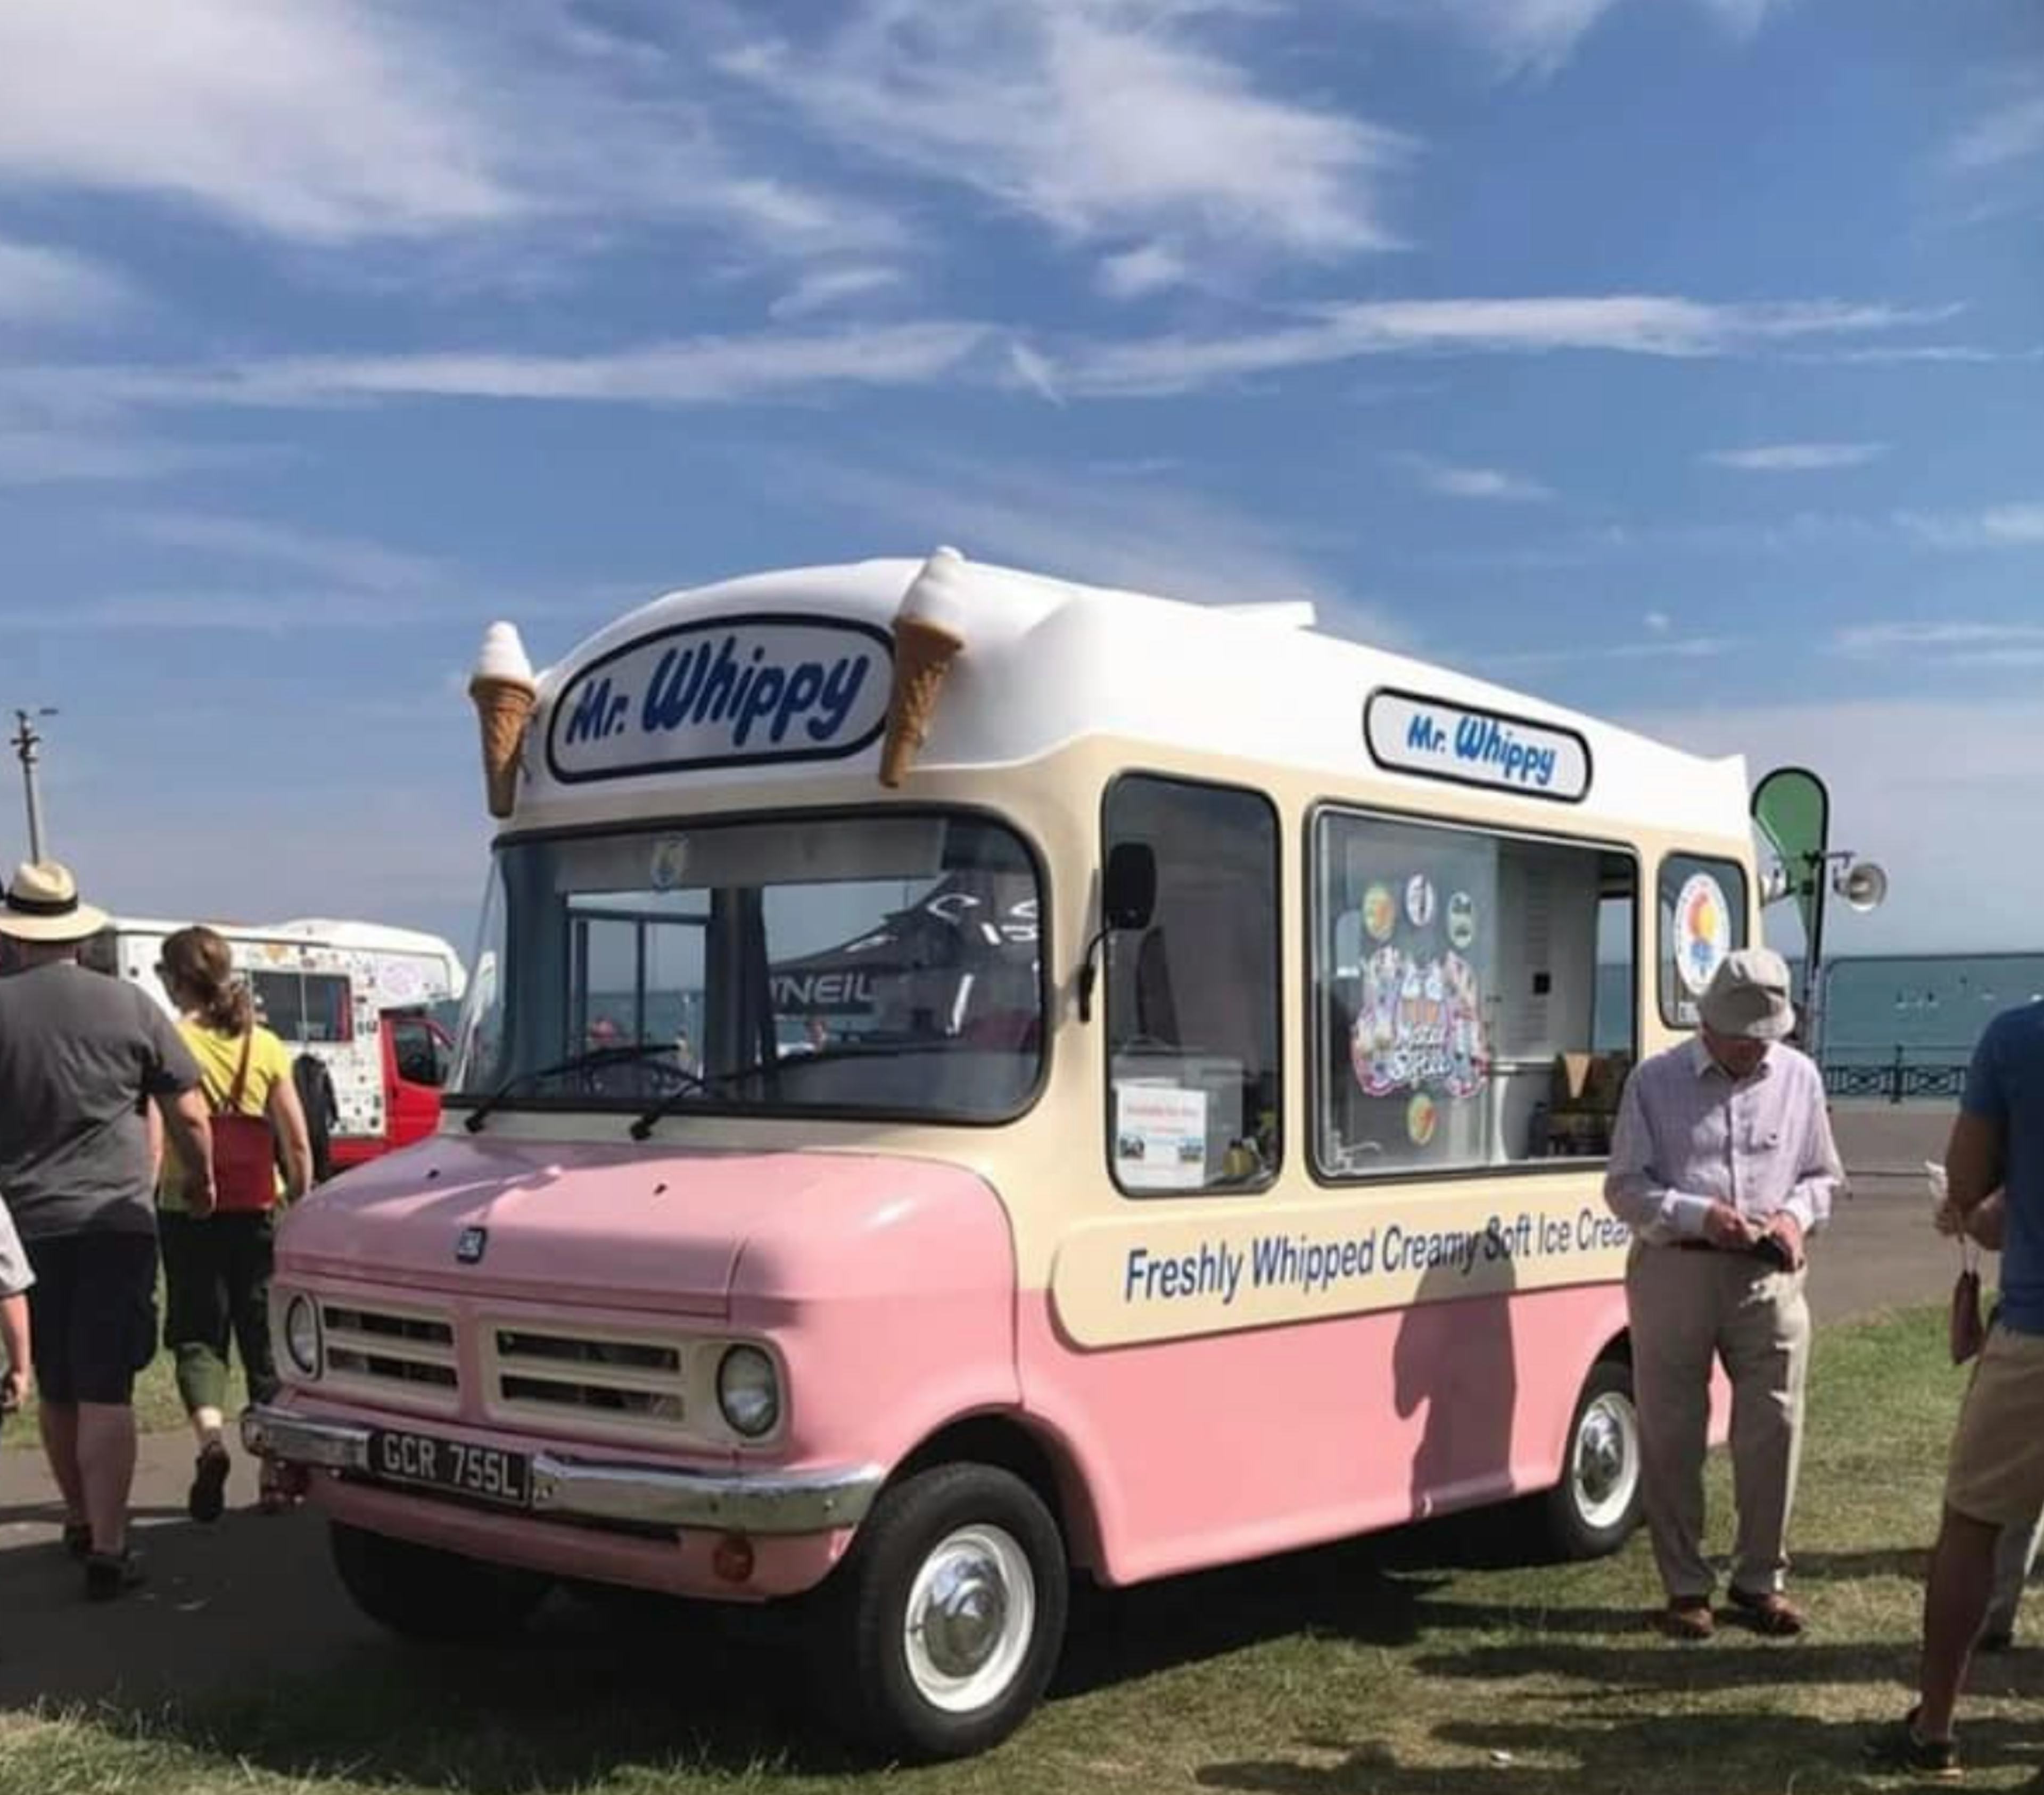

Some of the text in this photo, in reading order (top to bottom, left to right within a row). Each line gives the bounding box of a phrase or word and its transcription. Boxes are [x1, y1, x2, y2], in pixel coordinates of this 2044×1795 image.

[566, 635, 870, 746] Mr. Whippy
[1407, 714, 1555, 785] Mr. Whippy
[1125, 1207, 1629, 1304] Freshly Whipped Creamy Soft Ice Crea
[383, 1434, 520, 1496] GCR 755L
